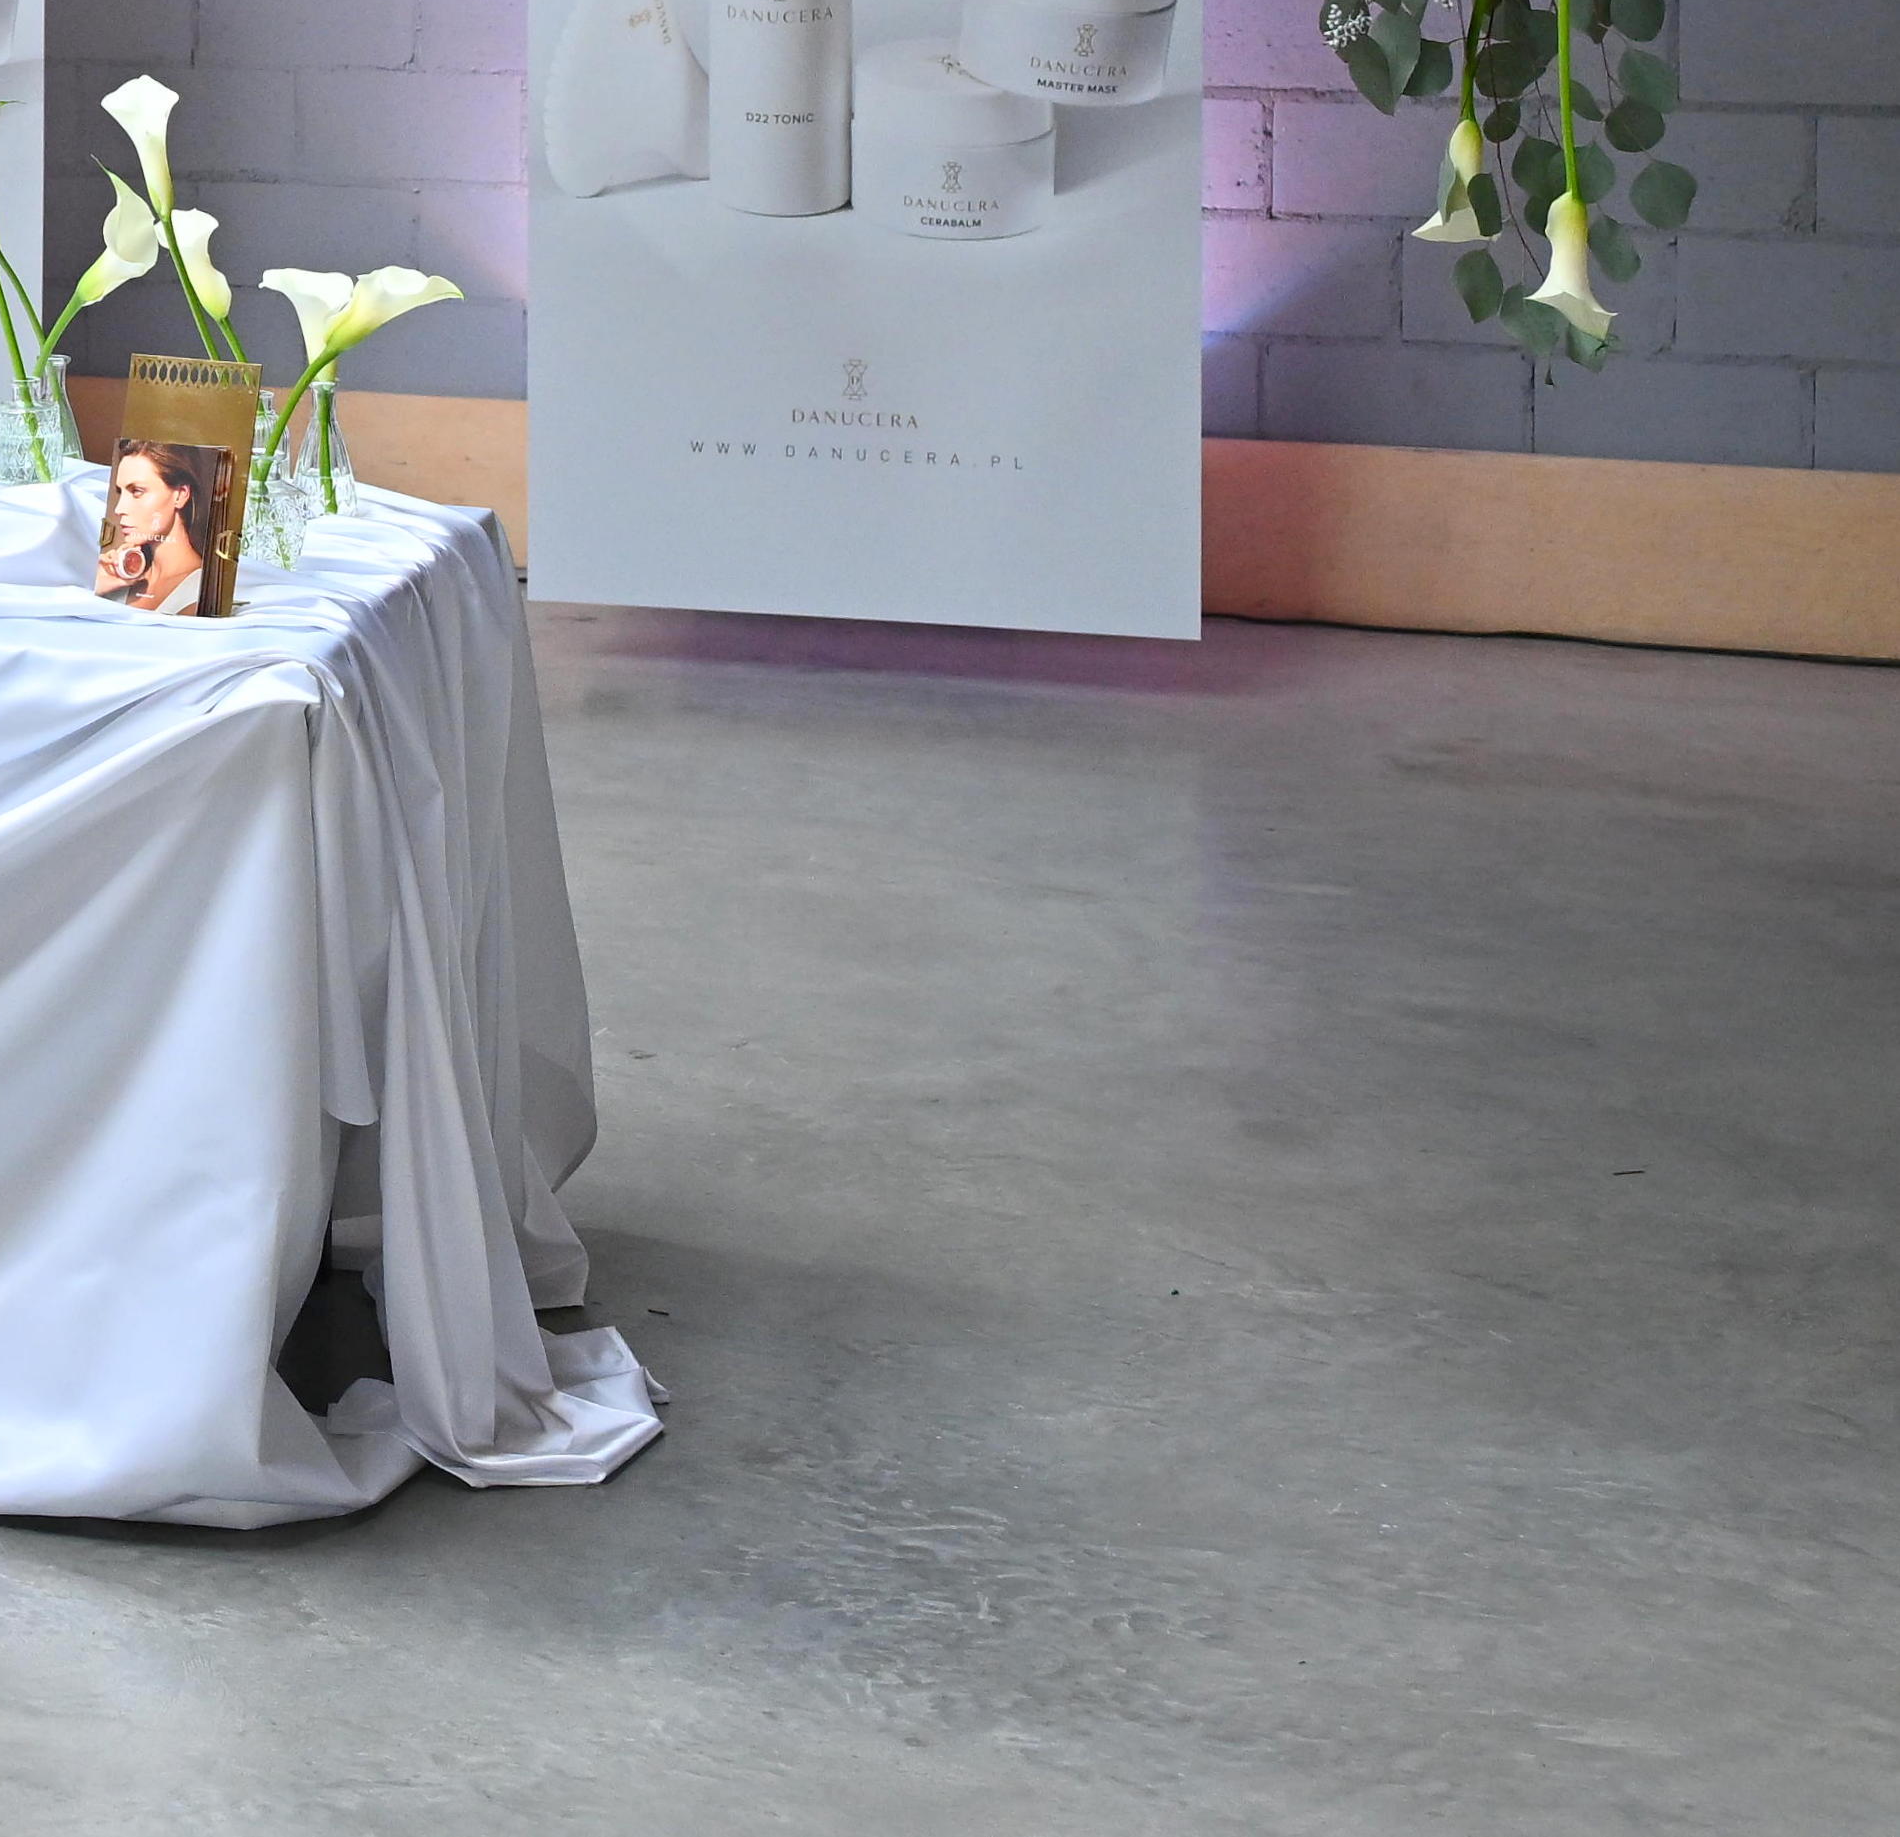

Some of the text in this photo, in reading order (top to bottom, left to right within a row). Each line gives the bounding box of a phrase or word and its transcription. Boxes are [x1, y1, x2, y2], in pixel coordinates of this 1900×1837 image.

[727, 4, 834, 24] DANUCERA
[1029, 56, 1128, 77] DANUCERA
[1036, 78, 1118, 95] MASTER MASK
[745, 112, 815, 125] D22 TONIC
[903, 194, 1000, 213] DANUCERA
[920, 216, 981, 228] CERABALM
[792, 408, 918, 429] DANUCERA
